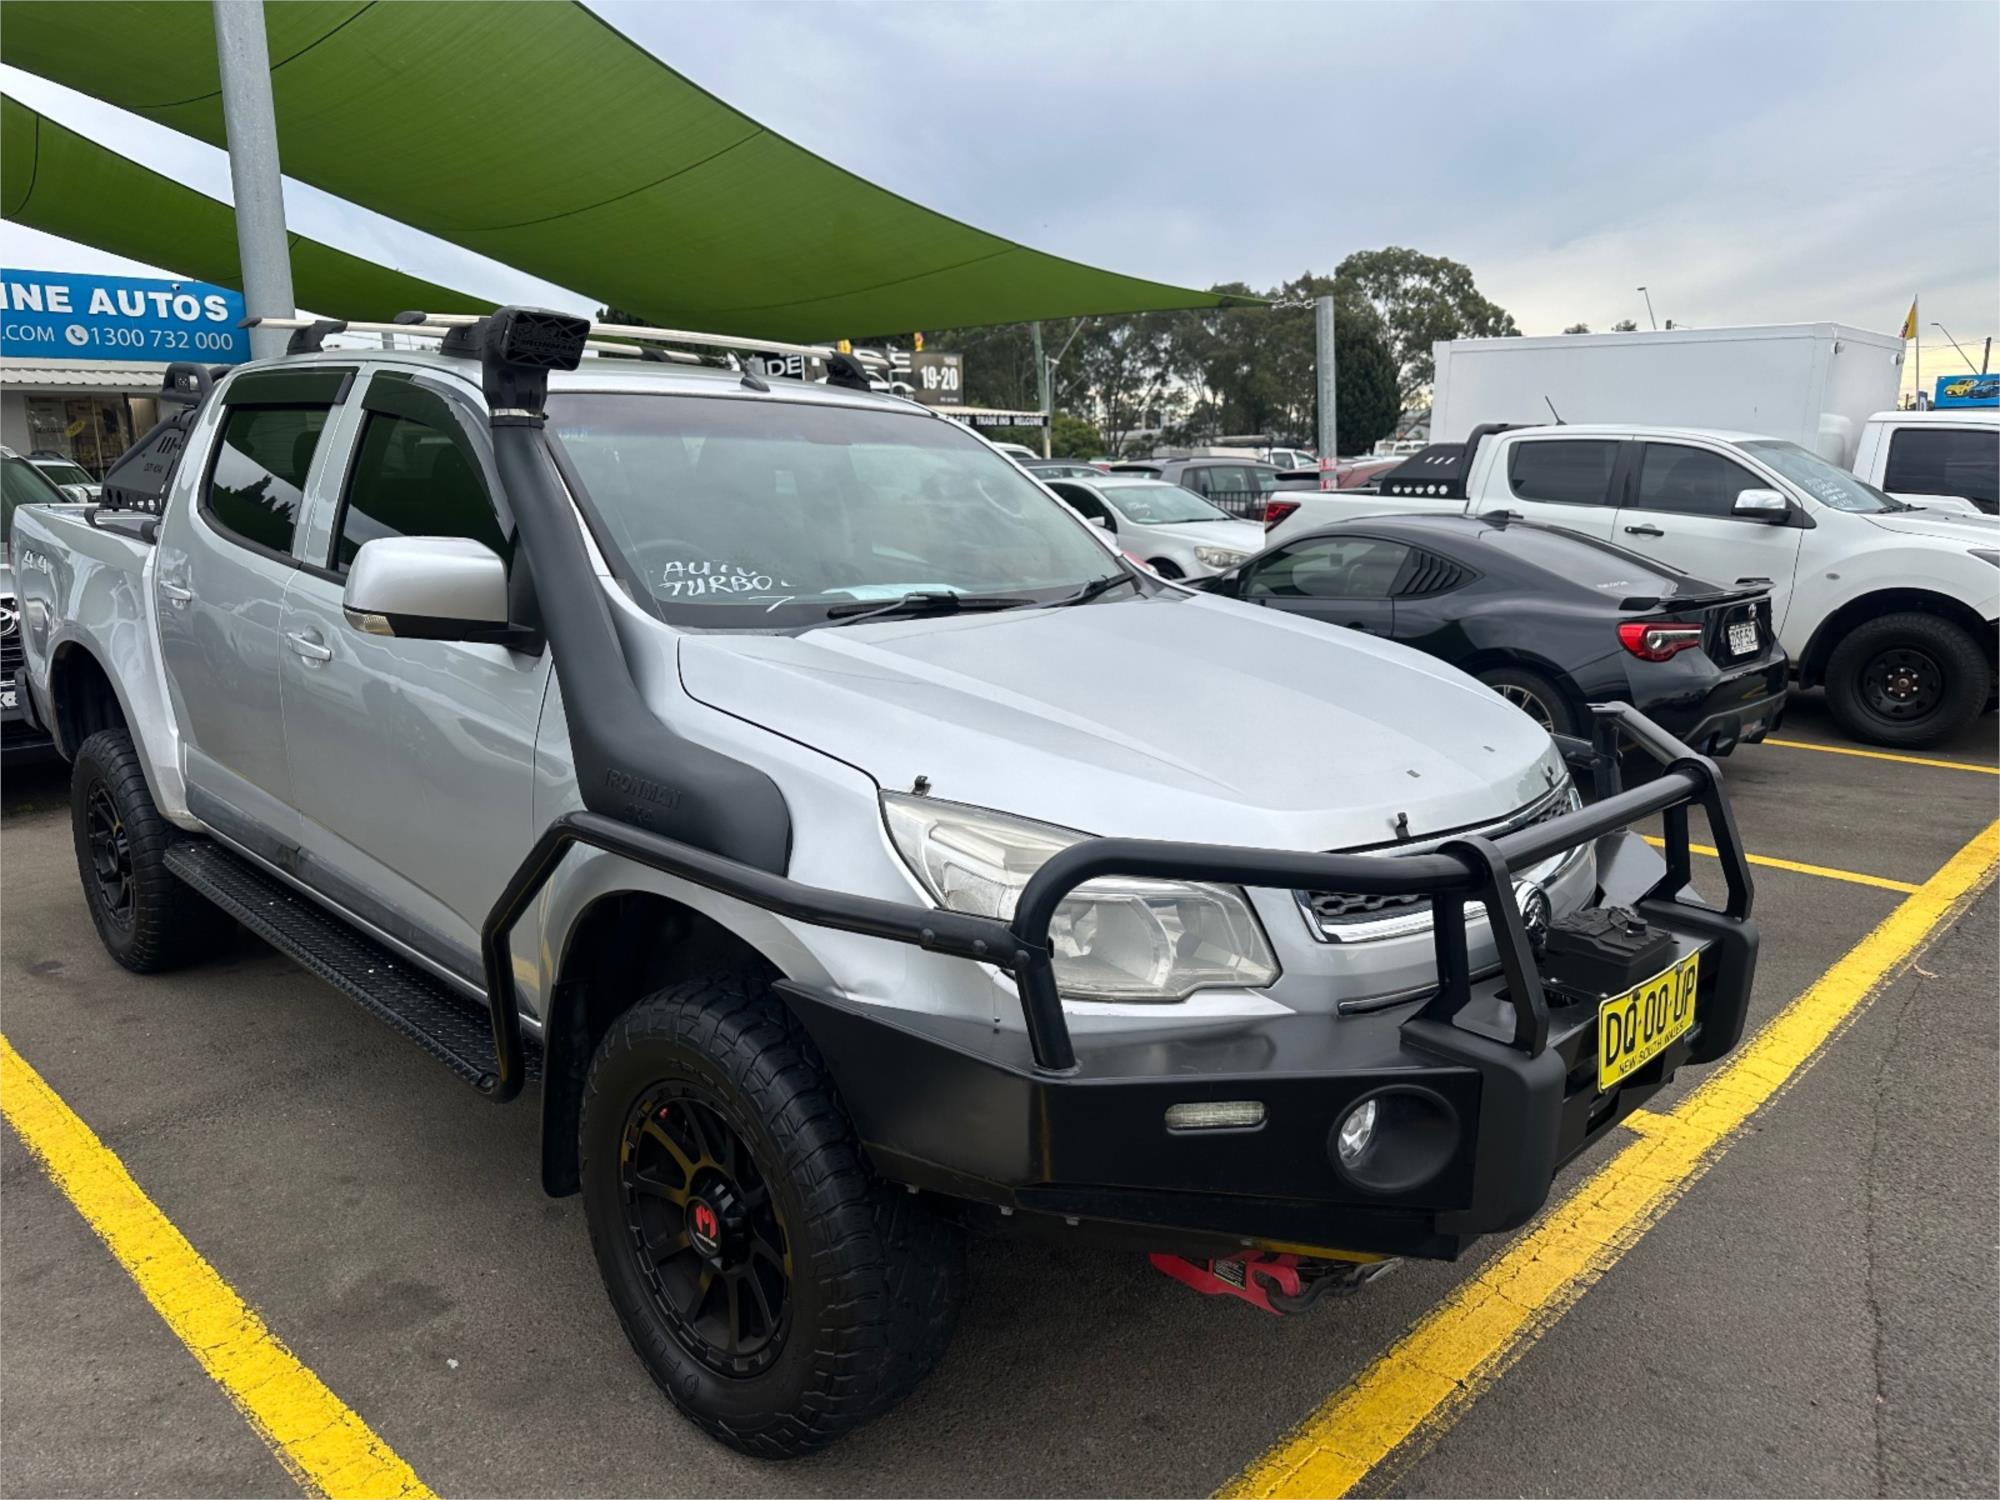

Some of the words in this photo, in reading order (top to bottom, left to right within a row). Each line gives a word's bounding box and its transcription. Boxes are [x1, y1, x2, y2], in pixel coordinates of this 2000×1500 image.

[88, 288, 229, 322] AUTOS
[91, 328, 144, 347] 1300
[150, 330, 190, 349] 732
[195, 333, 233, 350] 000
[920, 366, 959, 391] 19-20
[1013, 416, 1044, 427] WELCOME
[658, 575, 772, 597] TURBO
